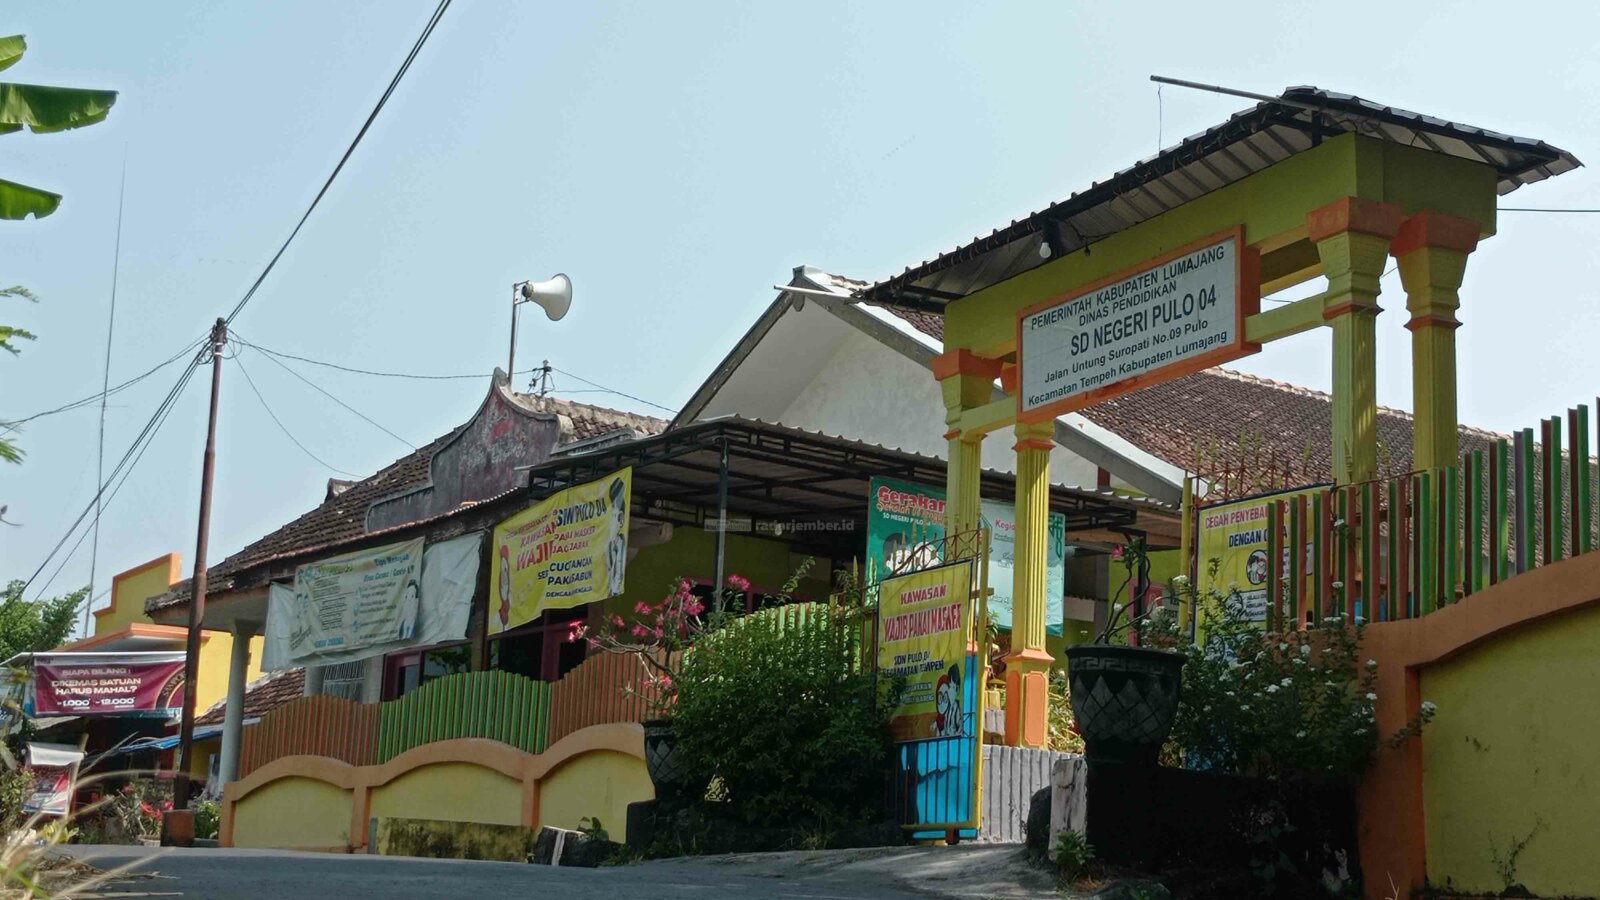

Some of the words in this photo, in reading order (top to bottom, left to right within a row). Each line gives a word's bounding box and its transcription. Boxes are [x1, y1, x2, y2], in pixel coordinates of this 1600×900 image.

[1031, 297, 1092, 330] PEMERINTAH
[1096, 271, 1158, 305] KABUPATEN
[1163, 245, 1225, 281] LUMAJANG
[1079, 307, 1109, 327] DINAS
[1112, 281, 1177, 314] PENDIDIKAN
[1071, 332, 1089, 356] SD
[1093, 309, 1148, 349] NEGERI
[1152, 293, 1194, 328] PULO
[1199, 284, 1217, 311] 04
[1045, 367, 1069, 384] Jalan
[1072, 355, 1106, 374] Untung
[1108, 338, 1150, 361] Suropati
[1152, 328, 1182, 346] No.09
[1184, 319, 1208, 335] Pulo
[1028, 383, 1078, 407] Kecamatan
[1080, 367, 1117, 388] Tempeh
[1119, 349, 1173, 374] Kabupaten
[1176, 330, 1228, 356] Lumajang
[910, 517, 924, 526] PLO
[1205, 513, 1229, 529] CEGAH
[1229, 529, 1261, 548] DENGAN
[900, 585, 947, 605] KAWASAN
[91, 667, 126, 675] BILANG
[51, 679, 98, 688] DIKEMAS
[99, 678, 142, 686] SATUAN
[55, 687, 93, 696] HARUS
[95, 686, 138, 695] MAHAL?
